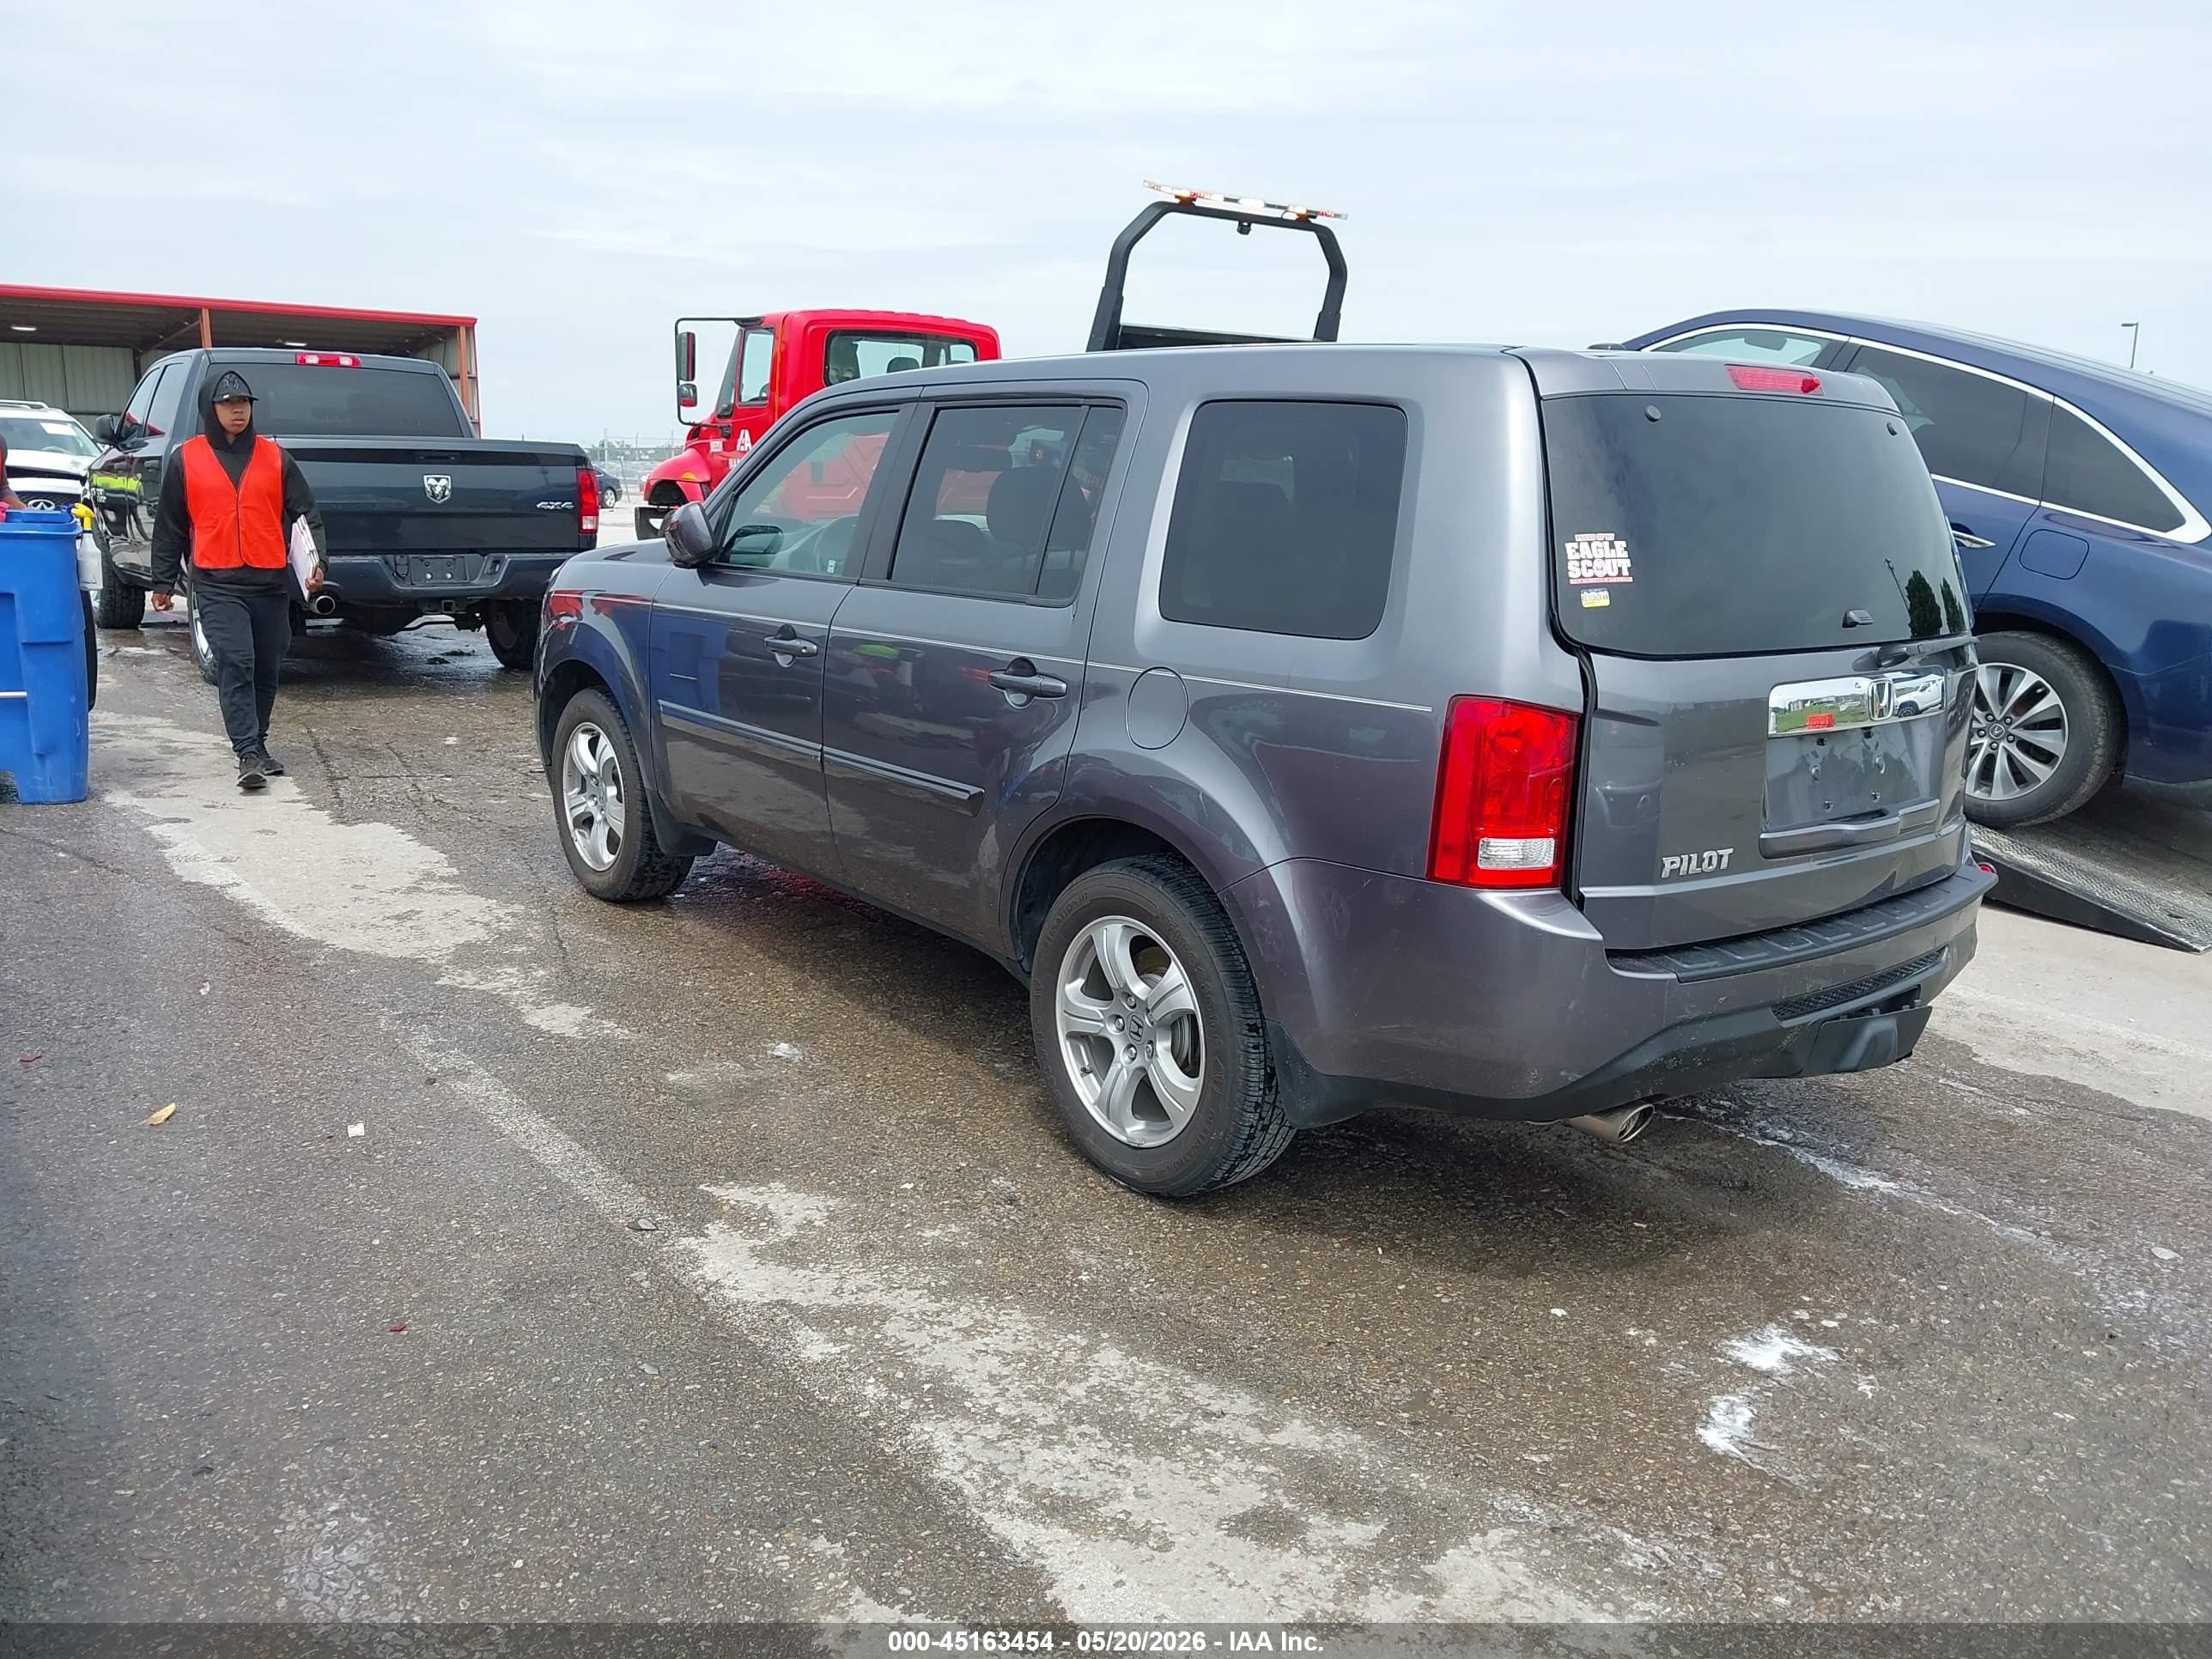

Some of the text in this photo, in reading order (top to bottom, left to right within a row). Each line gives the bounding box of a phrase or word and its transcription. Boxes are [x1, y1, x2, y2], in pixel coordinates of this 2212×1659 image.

[1565, 540, 1629, 560] EAGLE
[1567, 558, 1632, 579] SCOUT
[1662, 848, 1734, 878] PILOT
